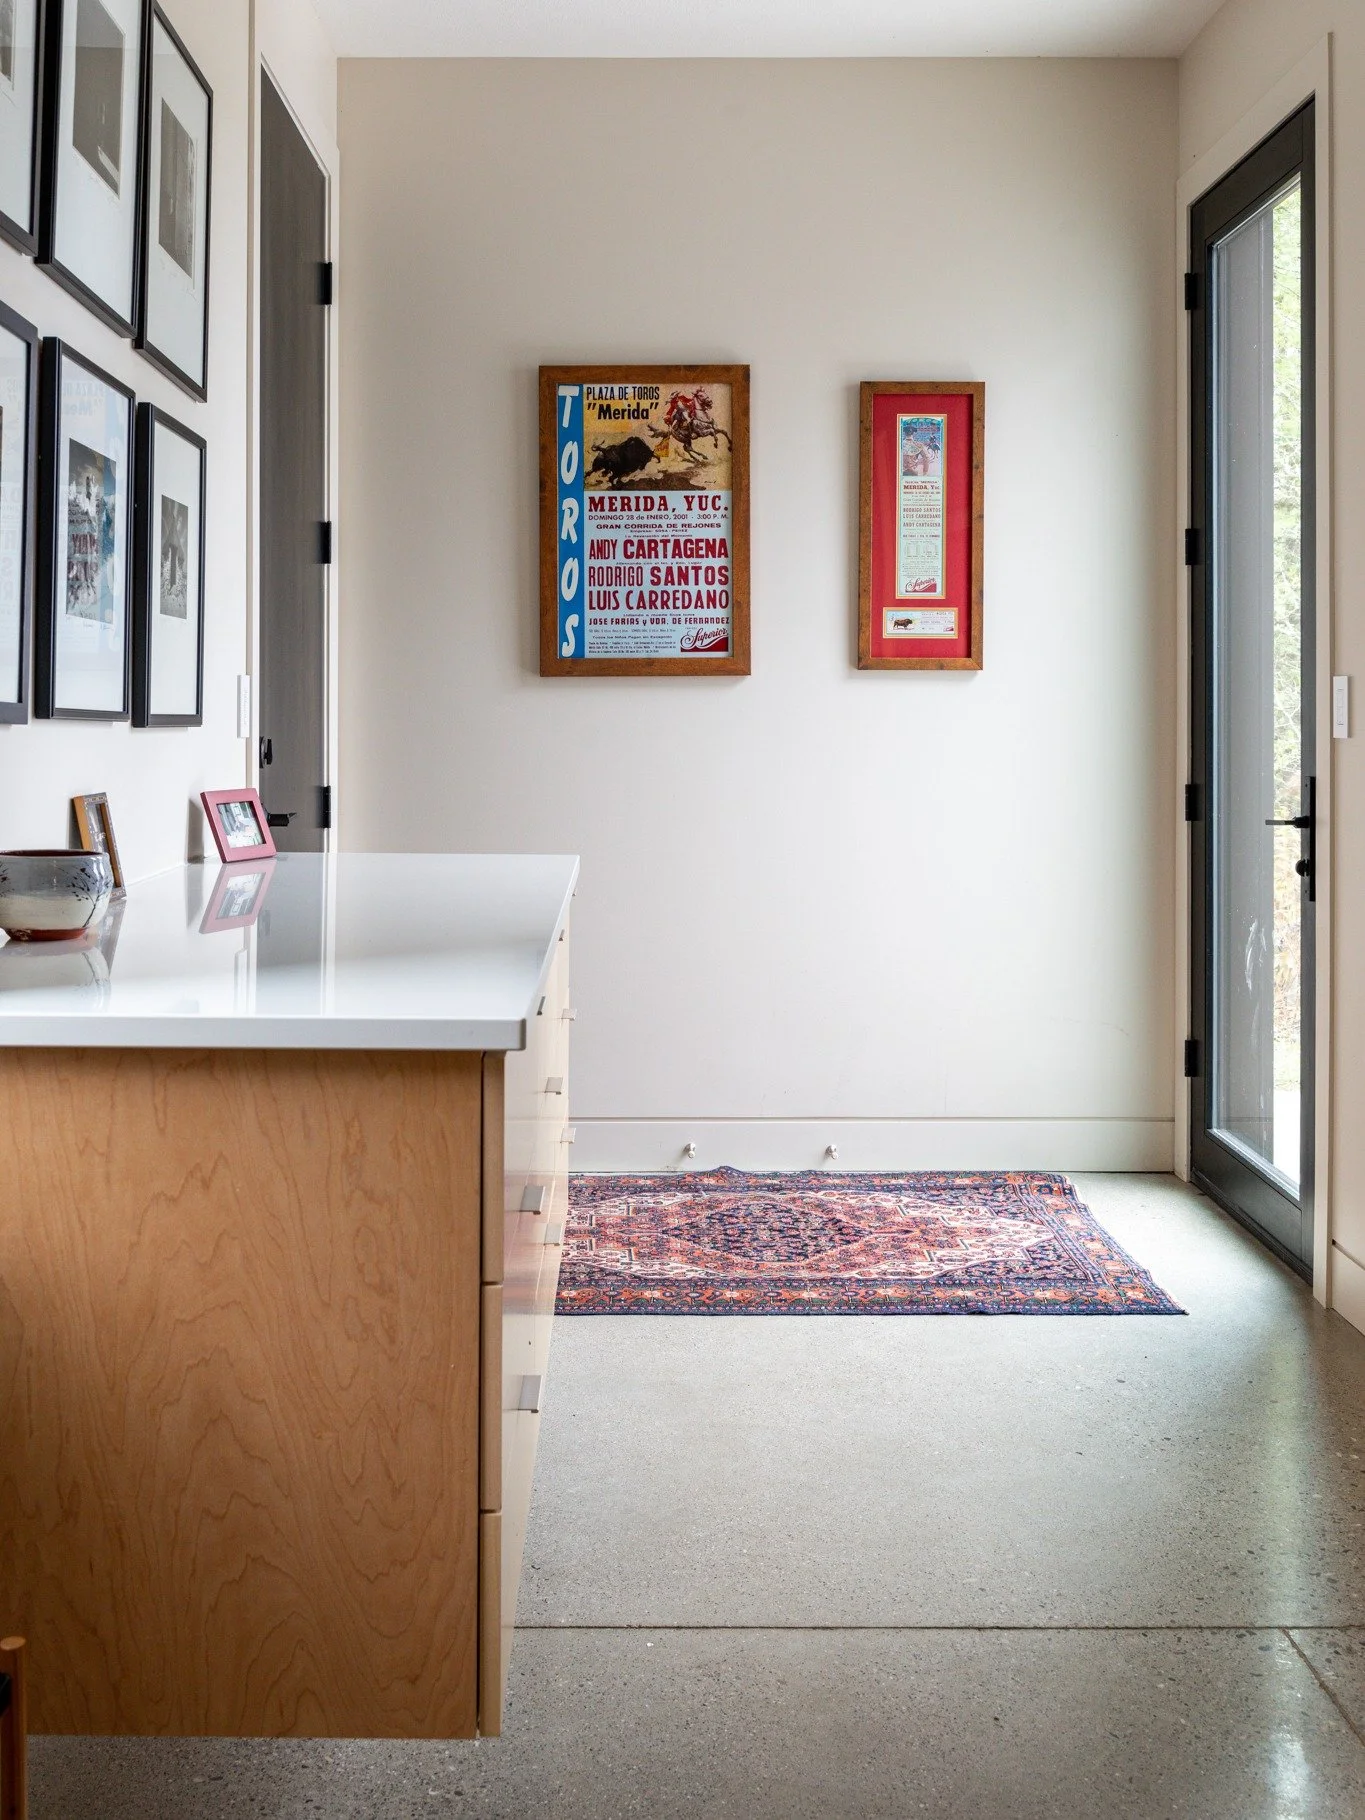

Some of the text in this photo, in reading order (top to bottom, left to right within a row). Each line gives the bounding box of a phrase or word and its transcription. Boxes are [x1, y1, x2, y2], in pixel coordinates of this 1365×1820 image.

[586, 386, 660, 400] PLAZA DE TOROS
[587, 402, 659, 420] "Merida"
[588, 495, 729, 512] MERIDA, YUC.
[558, 386, 580, 658] TOROS
[589, 538, 729, 560] ANDY CARTAGENA
[588, 565, 729, 587] RODRIGO SANTOS
[588, 589, 729, 611] LUIS CARREDANO
[650, 617, 669, 625] VDA.
[672, 617, 682, 625] DE
[684, 616, 730, 625] FERNANDEZ
[681, 627, 728, 649] Superior
